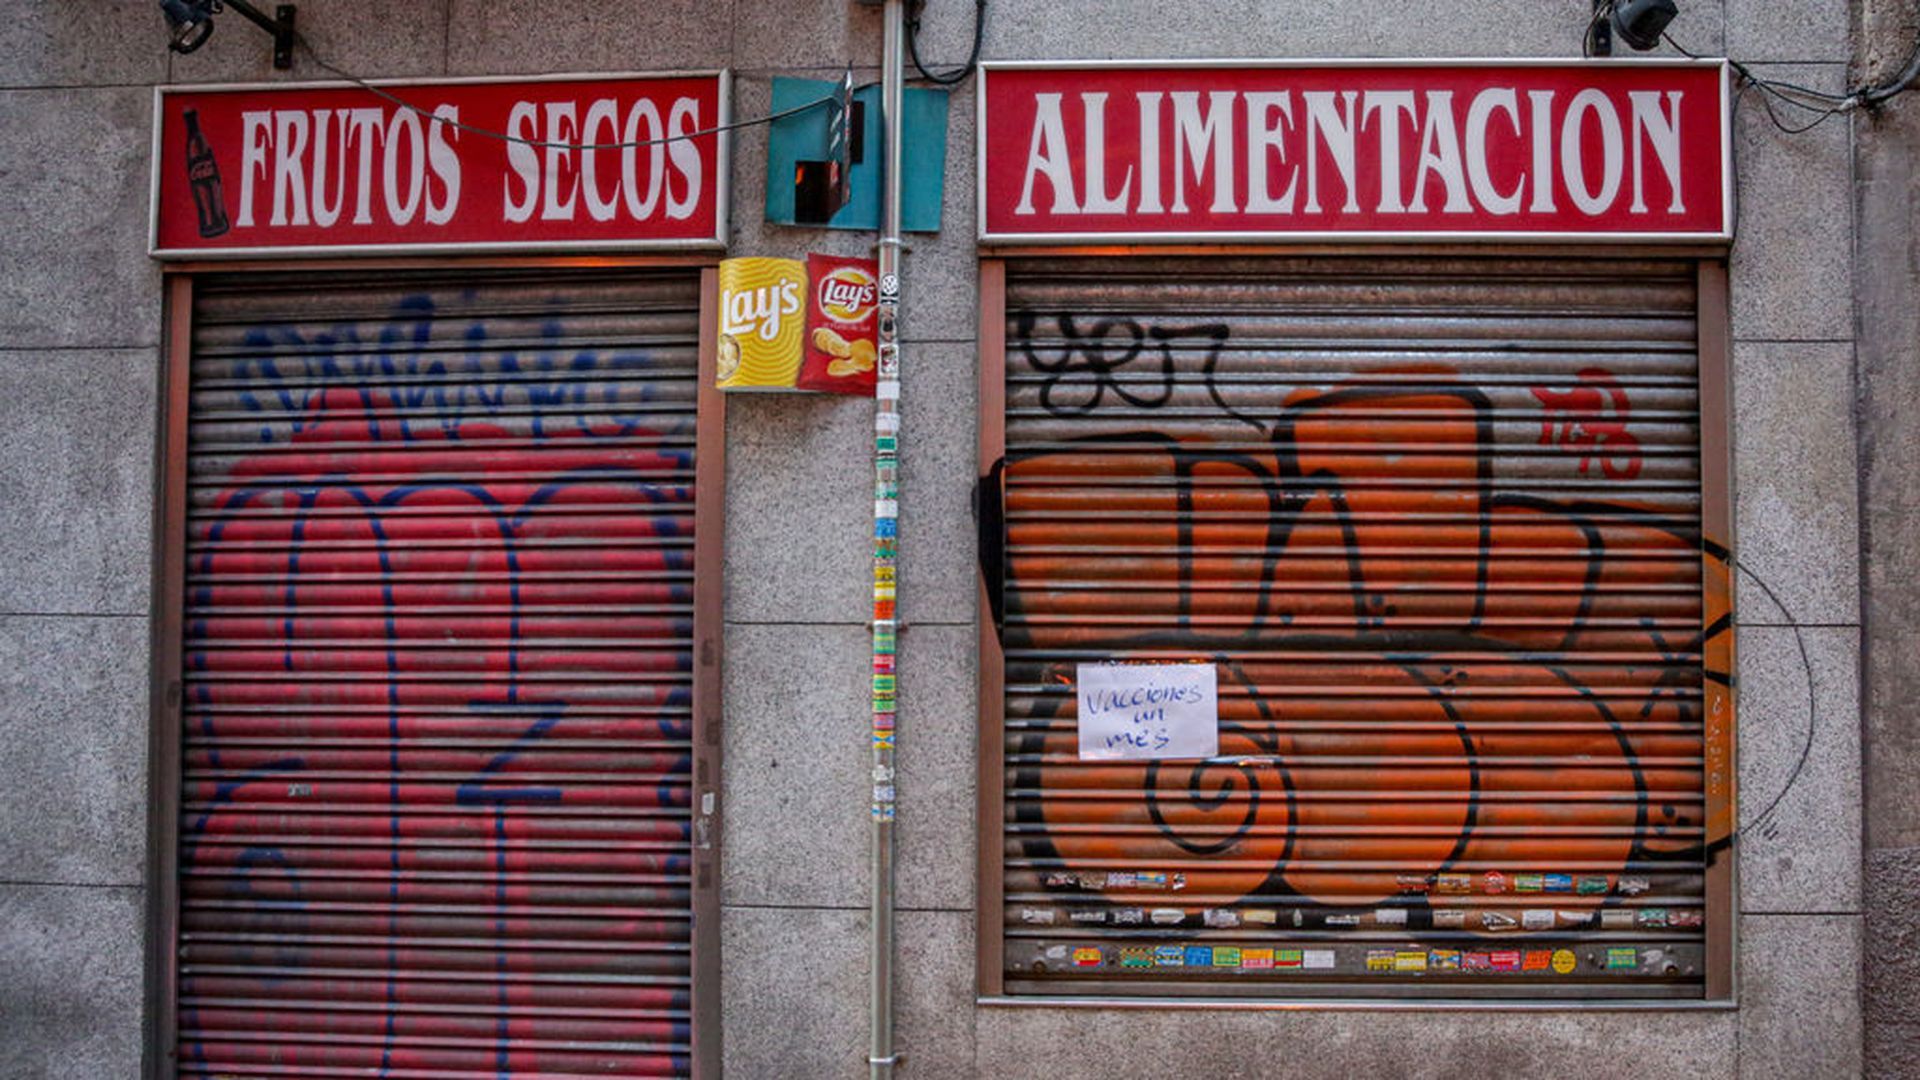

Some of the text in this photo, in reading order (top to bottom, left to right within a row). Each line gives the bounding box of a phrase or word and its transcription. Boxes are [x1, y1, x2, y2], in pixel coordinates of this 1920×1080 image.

[236, 97, 703, 228] FRUTOS SECOS
[1014, 88, 1687, 216] ALIMENTACION
[722, 278, 799, 340] Lay's
